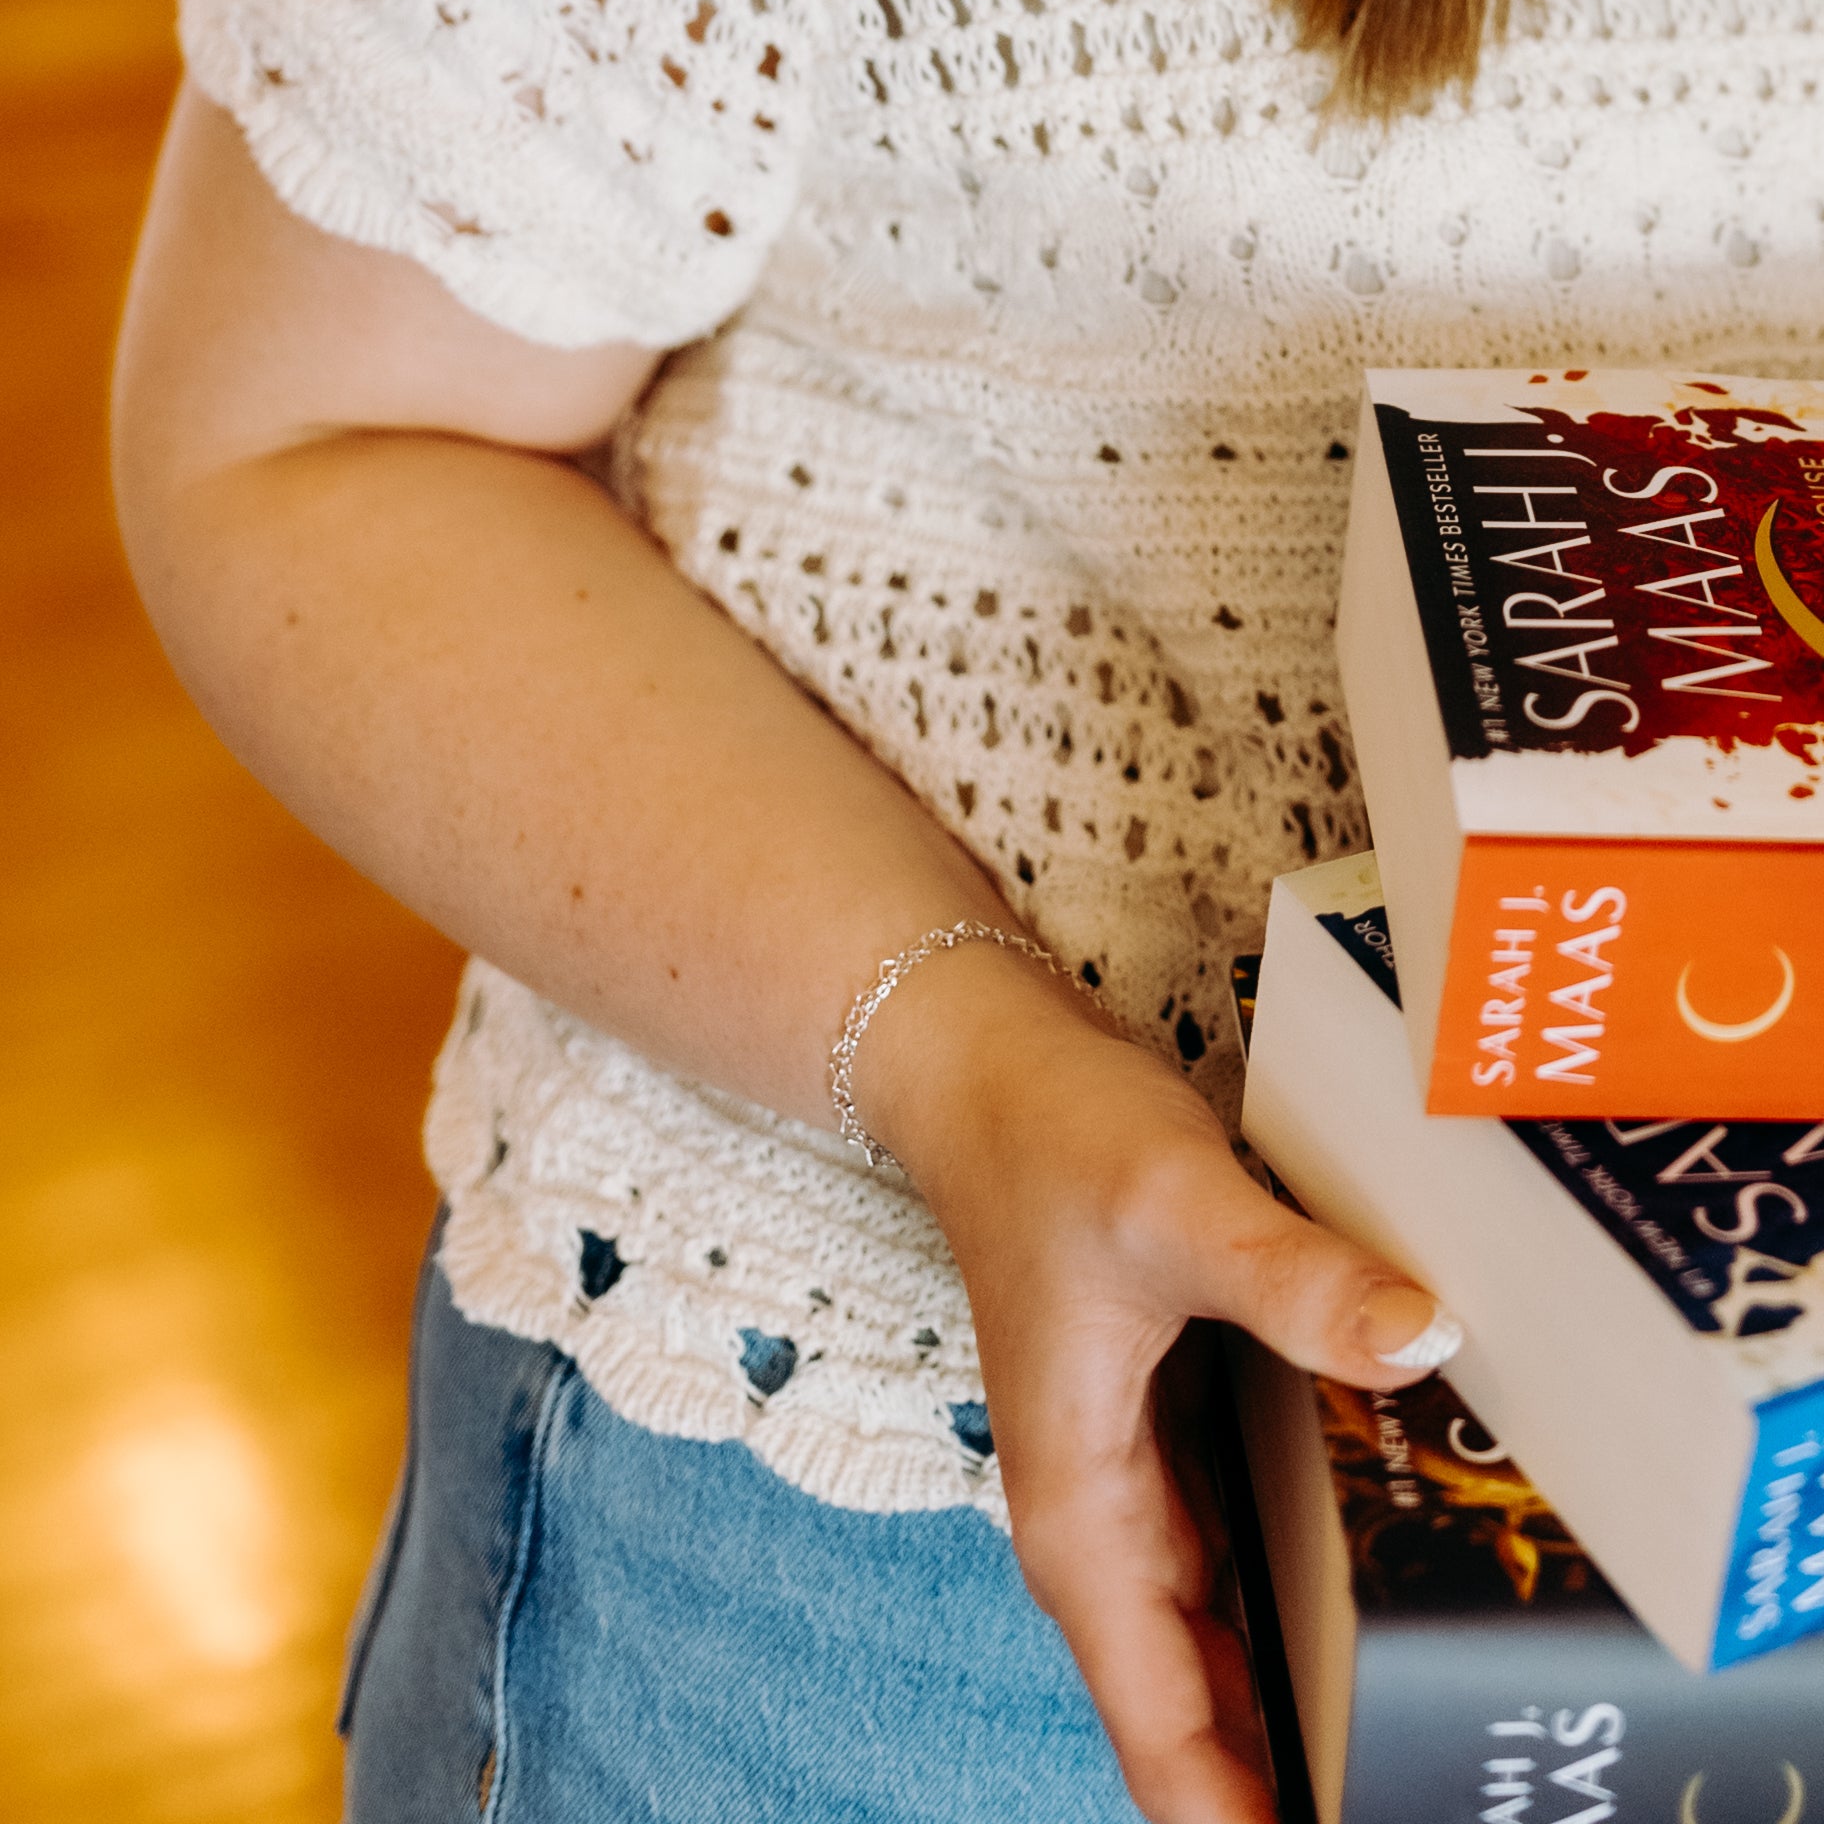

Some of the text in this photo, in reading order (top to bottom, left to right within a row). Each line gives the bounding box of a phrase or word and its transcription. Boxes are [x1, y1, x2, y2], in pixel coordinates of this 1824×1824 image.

[1418, 432, 1510, 743] #1 NEW YORK TIMES BESTSELLER
[1463, 432, 1640, 734] SARAH J.
[1602, 465, 1783, 703] MAAS
[1471, 884, 1551, 1087] SARAH J.
[1534, 885, 1627, 1086] MAAS
[1583, 1165, 1650, 1223] YORK
[1378, 1417, 1413, 1475] NEW
[1737, 1471, 1805, 1641] SARAH
